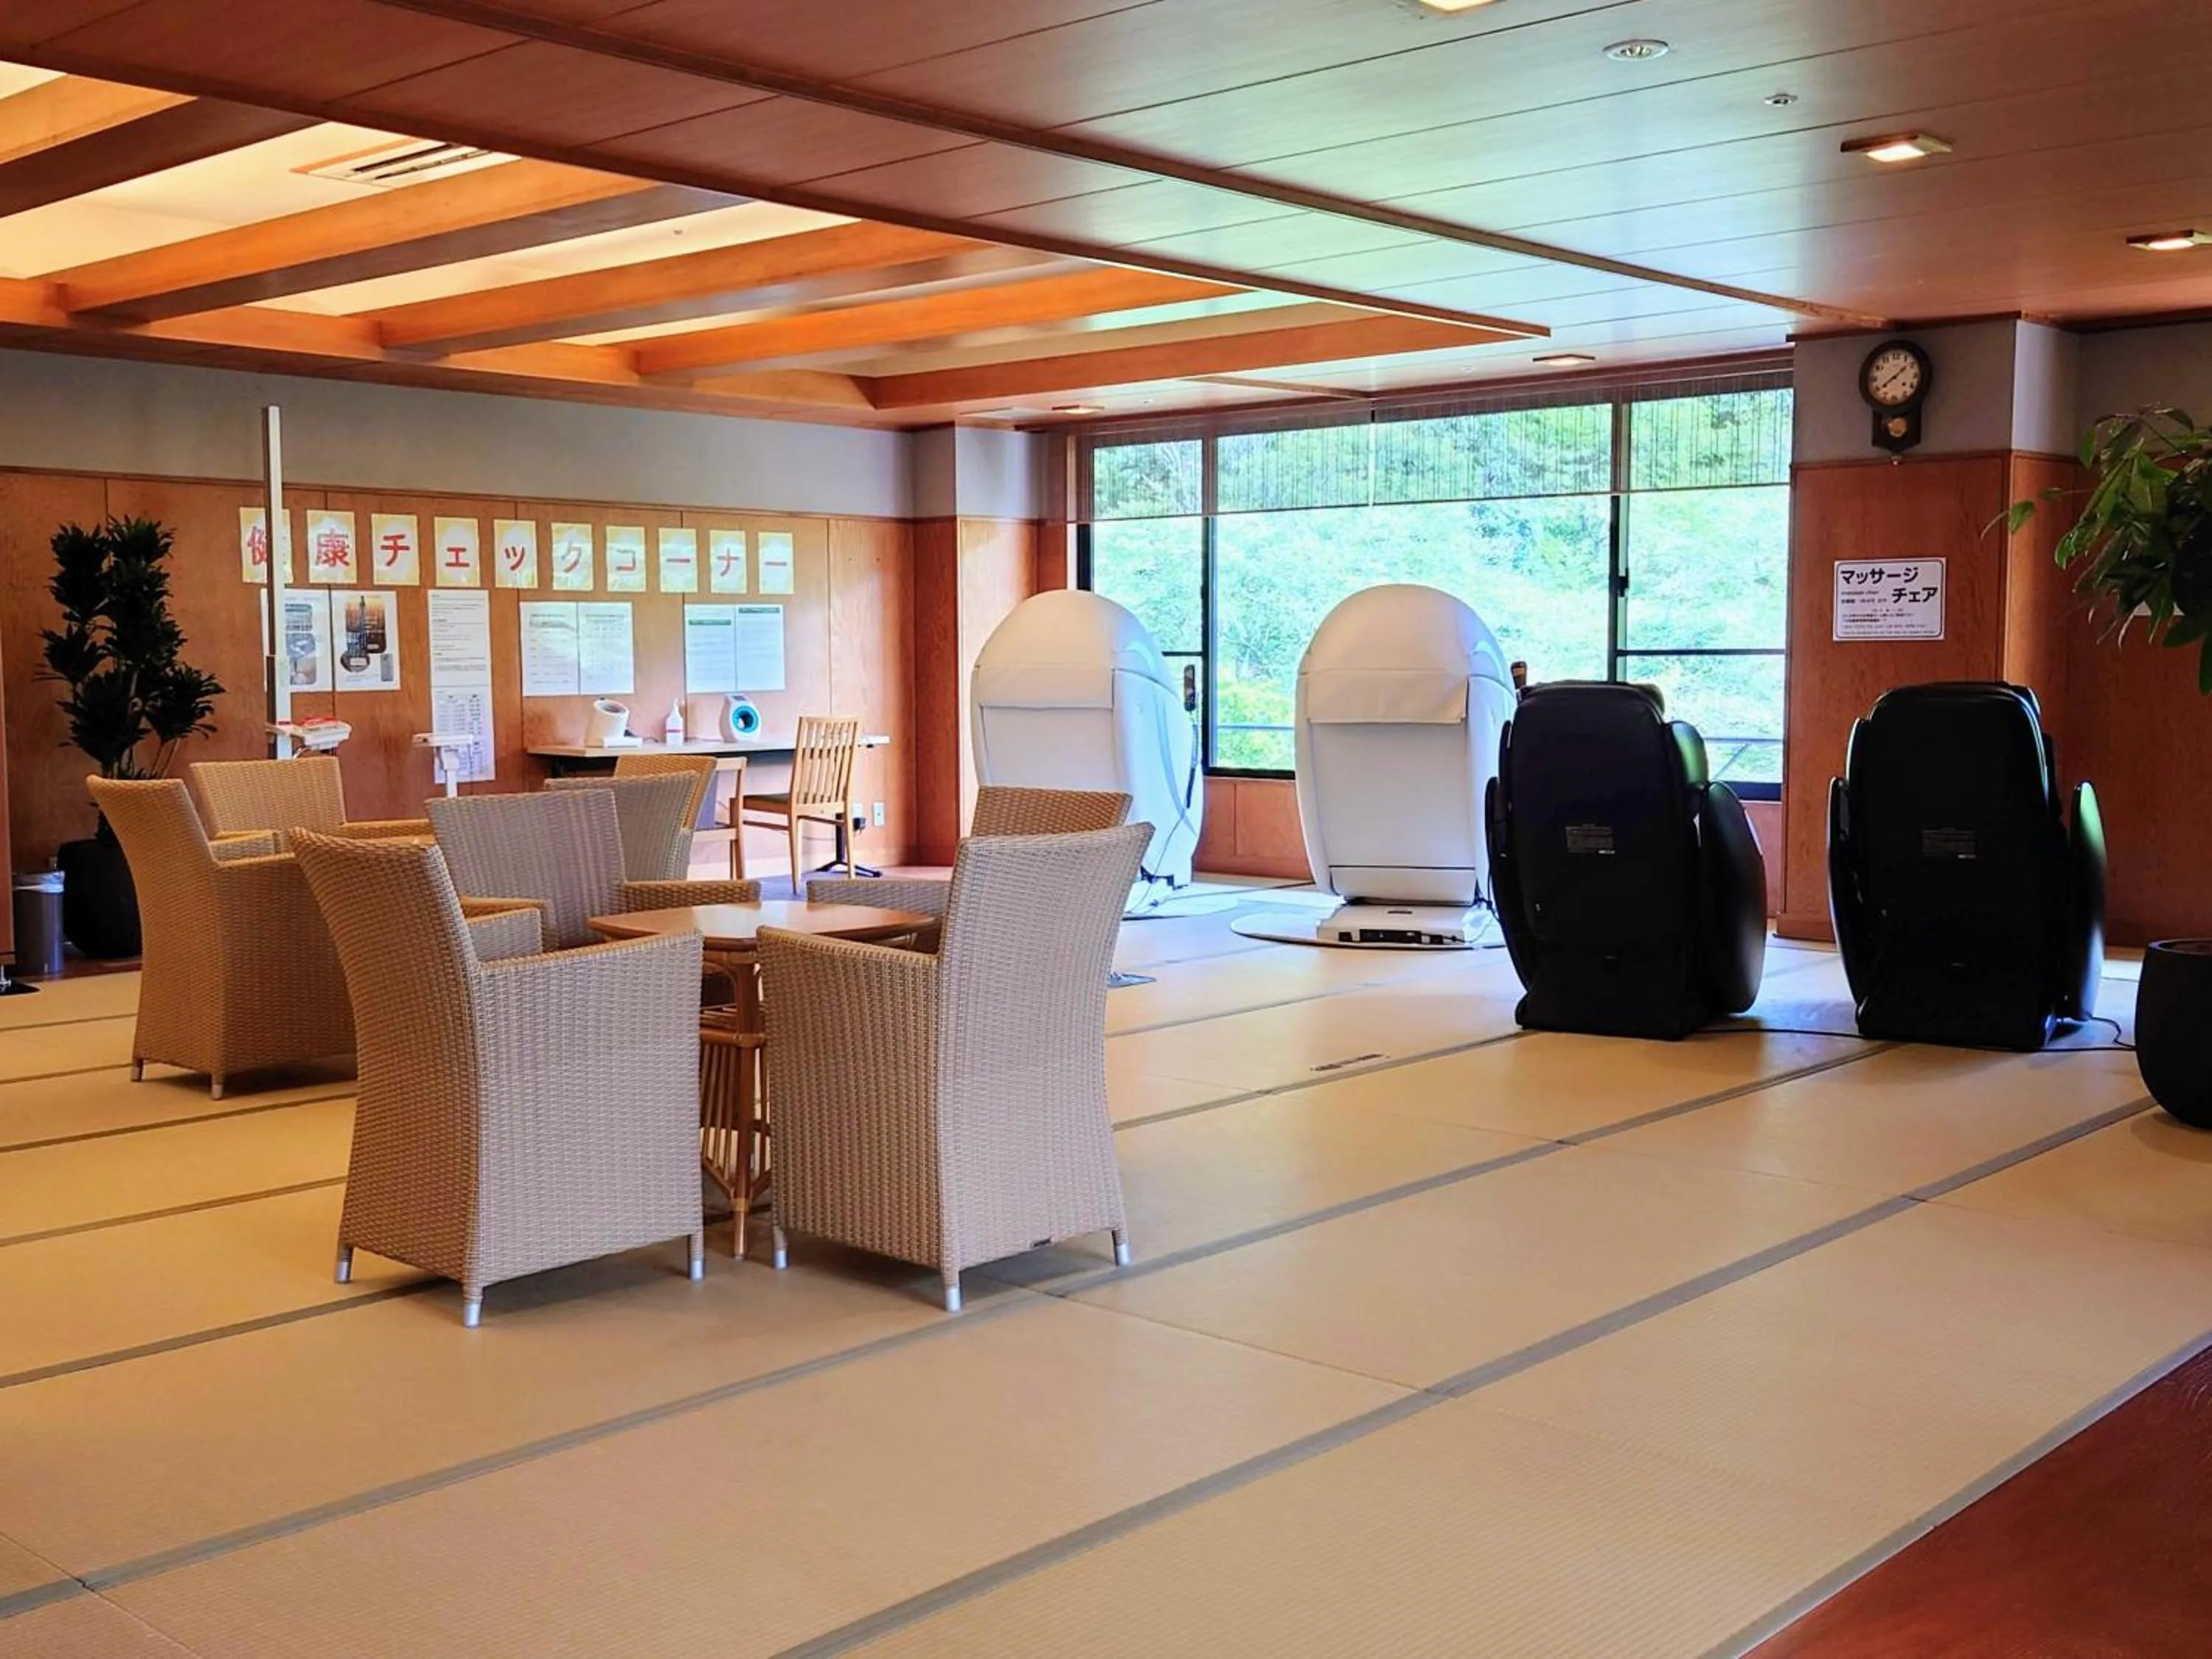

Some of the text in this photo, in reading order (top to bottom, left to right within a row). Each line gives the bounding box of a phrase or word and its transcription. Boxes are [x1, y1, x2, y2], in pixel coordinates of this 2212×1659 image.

[1840, 566, 1919, 585] マッサージ
[1891, 586, 1938, 604] チェア
